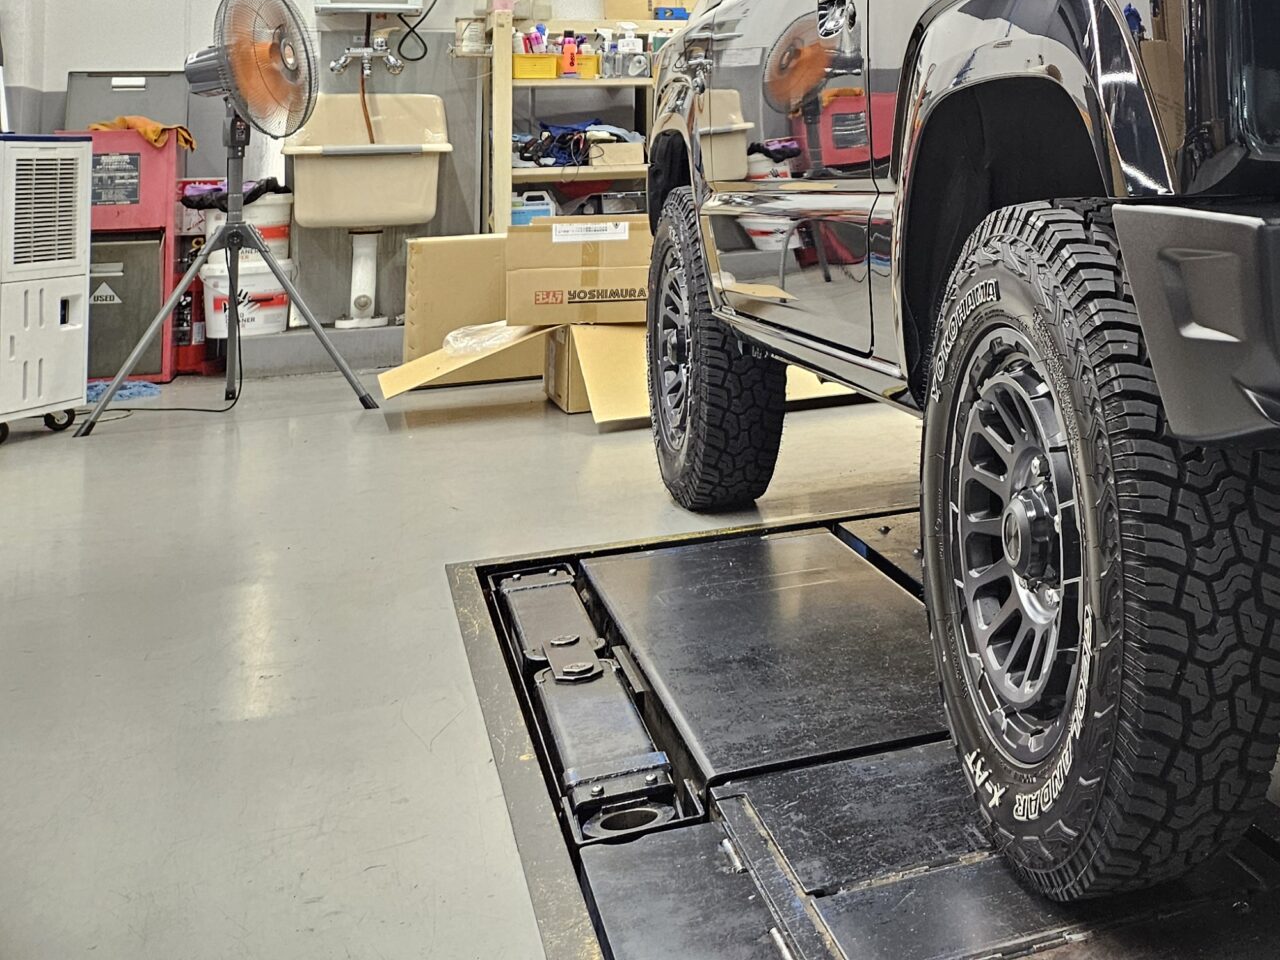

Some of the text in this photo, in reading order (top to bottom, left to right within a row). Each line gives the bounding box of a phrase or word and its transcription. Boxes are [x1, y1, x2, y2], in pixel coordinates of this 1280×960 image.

[93, 294, 115, 302] USED
[535, 290, 564, 305] ヨシムラ
[568, 288, 647, 300] YOSHIMURA
[931, 279, 1001, 403] YOKOHAMA
[1013, 603, 1095, 821] GEOLANDAR
[964, 748, 1009, 809] X-AT
